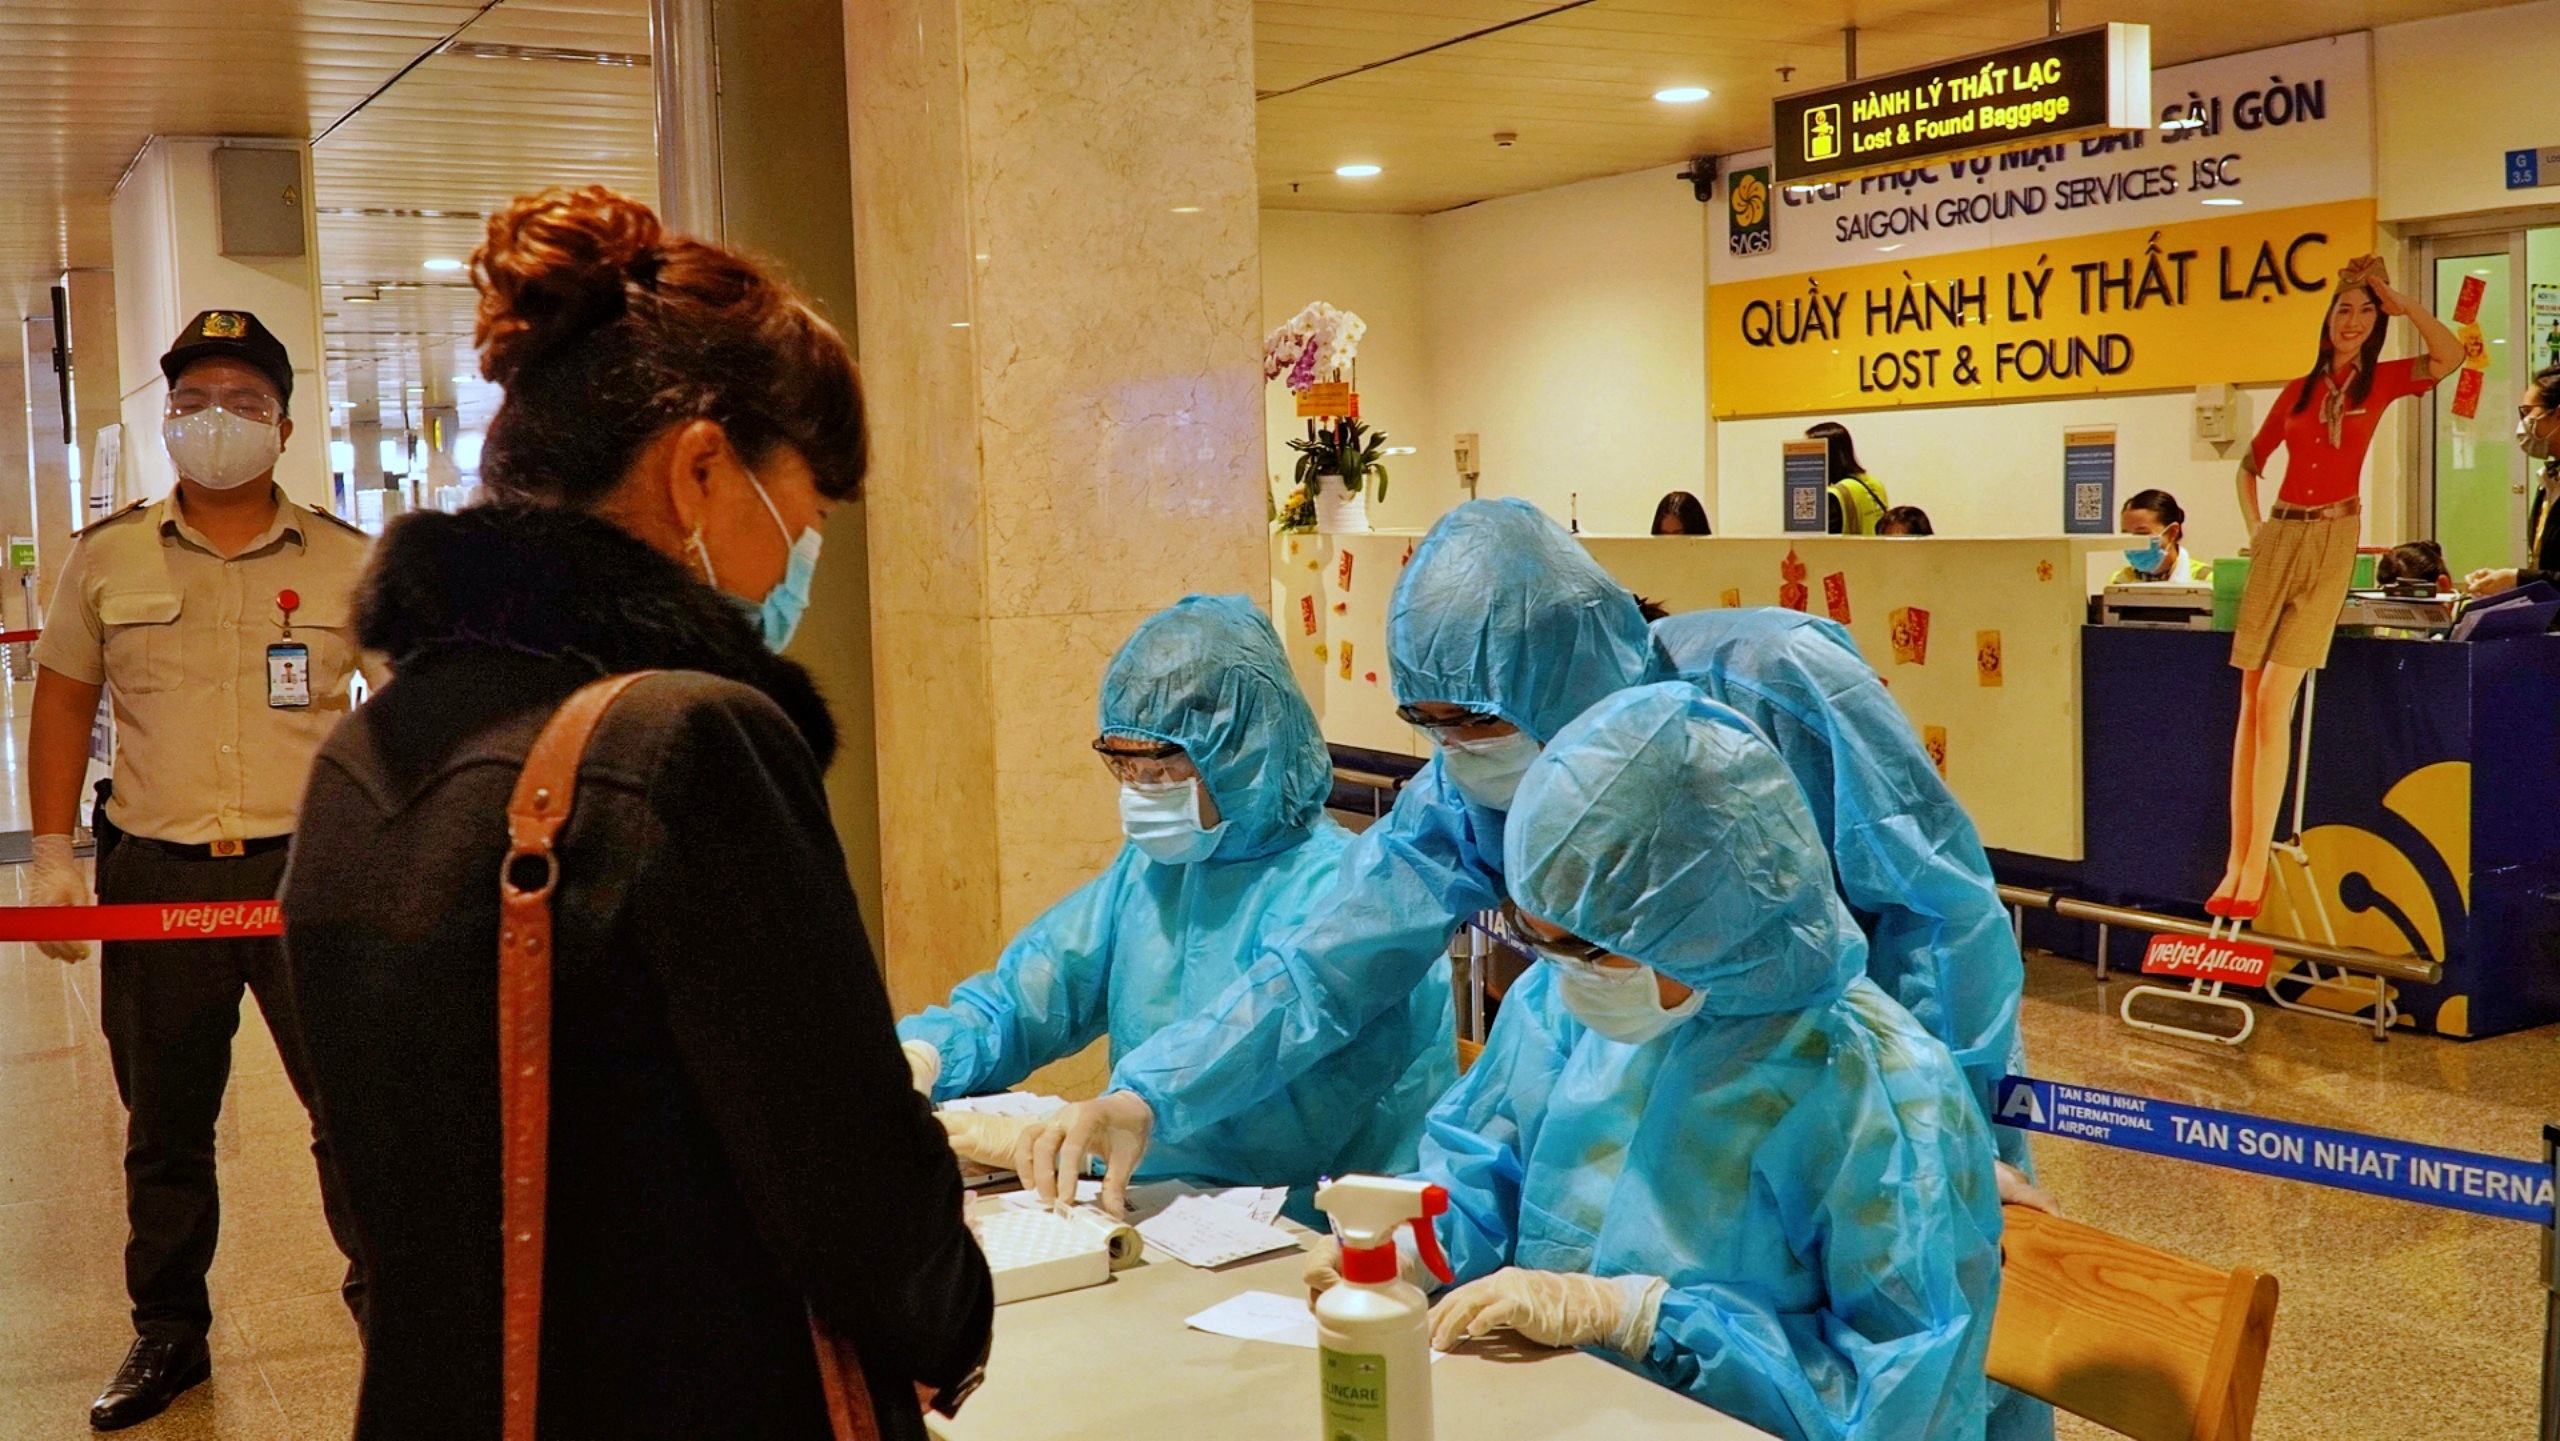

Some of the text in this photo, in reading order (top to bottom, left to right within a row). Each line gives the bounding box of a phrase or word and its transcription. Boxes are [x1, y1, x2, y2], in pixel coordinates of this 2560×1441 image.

[1852, 57, 2061, 123] HÀNH LÝ THẤT LẠC
[2161, 91, 2221, 143] SÀI
[2233, 76, 2325, 131] GÒN
[1852, 96, 2070, 153] Lost & Found Baggage
[2512, 170, 2532, 183] 3.5
[2515, 154, 2527, 167] G
[1836, 154, 2241, 243] SAIGON GROUND SERVICES JSC
[1729, 230, 1769, 256] SAGS
[1741, 230, 2328, 347] QUẦY HÀNH LÝ THẤT LẠC
[1859, 333, 2134, 392] LOST & FOUND
[2057, 1103, 2154, 1131] INTERNATIONAL
[2058, 1086, 2147, 1112] TAN SON NHAT
[2058, 1119, 2111, 1139] AIRPORT
[2170, 1116, 2555, 1206] TAN SON NHAT INTERNA
